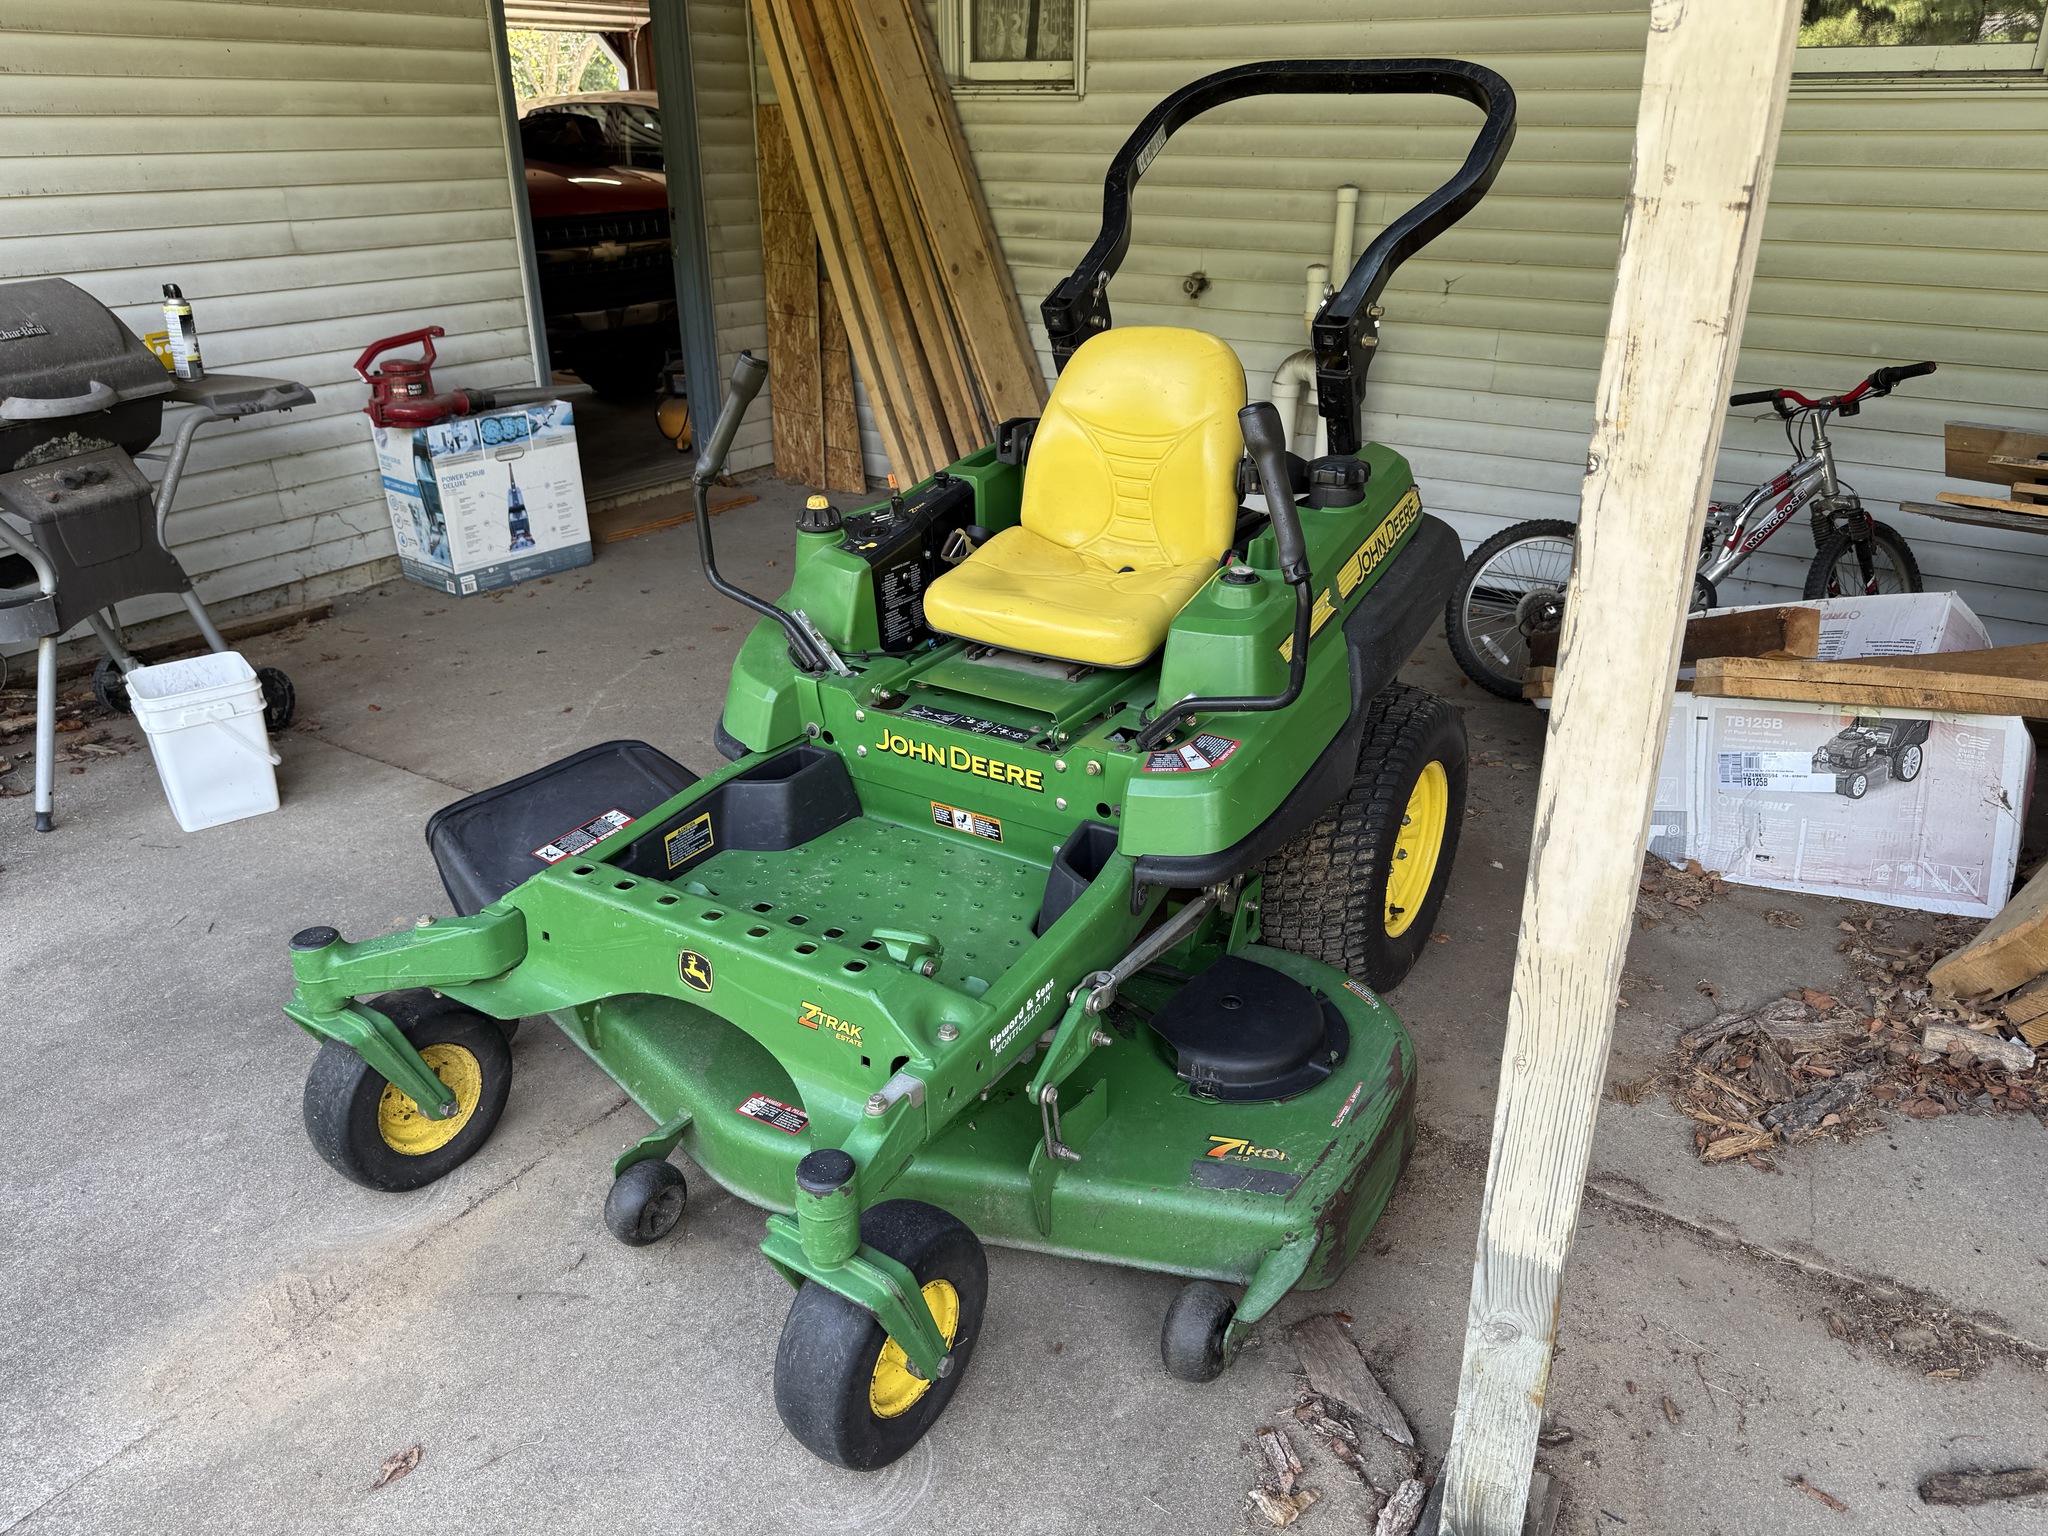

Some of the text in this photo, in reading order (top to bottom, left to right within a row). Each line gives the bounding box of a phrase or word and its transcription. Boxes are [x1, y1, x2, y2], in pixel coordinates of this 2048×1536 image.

[441, 468, 486, 483] POWER SCRUB
[442, 479, 467, 490] DELUXE
[1746, 489, 1806, 548] MONGOOSE
[1355, 497, 1417, 582] JOHN DEERE
[1725, 715, 1784, 730] TB125B
[875, 728, 1043, 792] JOHN DEERE
[1743, 777, 1769, 787] TB125B
[1043, 991, 1052, 1008] IN
[990, 977, 1055, 1050] Howard & Sons
[835, 1032, 863, 1048] ESTATE
